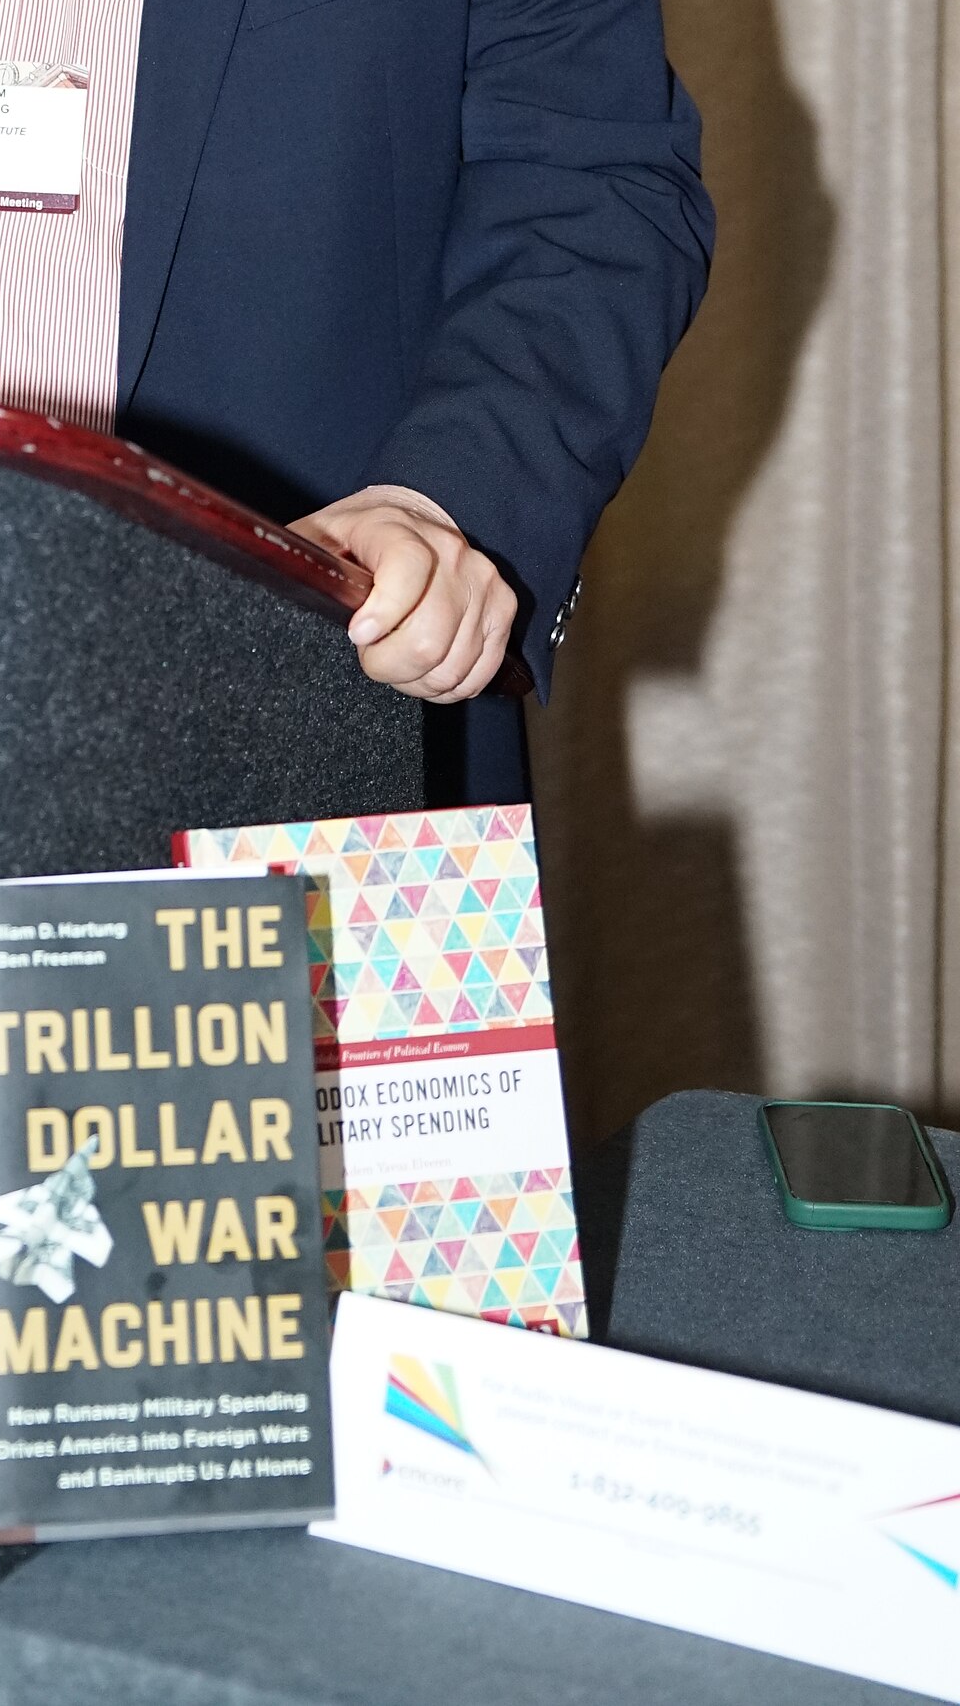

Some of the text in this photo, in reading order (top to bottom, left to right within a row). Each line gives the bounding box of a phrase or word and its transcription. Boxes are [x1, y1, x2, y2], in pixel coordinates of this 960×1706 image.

[0, 197, 43, 210] Meeting
[39, 923, 57, 939] D.
[58, 921, 128, 940] Hartung
[155, 905, 284, 971] THE
[32, 949, 106, 968] Freeman
[342, 1048, 381, 1063] Frontiers
[383, 1046, 392, 1060] of
[393, 1044, 431, 1057] Political
[433, 1042, 470, 1054] Economy
[317, 1069, 522, 1112] ODOX ECONOMICS OF
[26, 1098, 293, 1173] DOLLAR
[318, 1107, 489, 1146] LITARY SPENDING
[142, 1195, 299, 1266] WAR
[8, 1391, 308, 1426] How Runaway Military Spending
[60, 1433, 138, 1456] America
[141, 1431, 179, 1452] into
[183, 1427, 257, 1451] Foreign
[259, 1423, 311, 1444] Wars
[57, 1456, 312, 1490] and Bankrupts Us At Home
